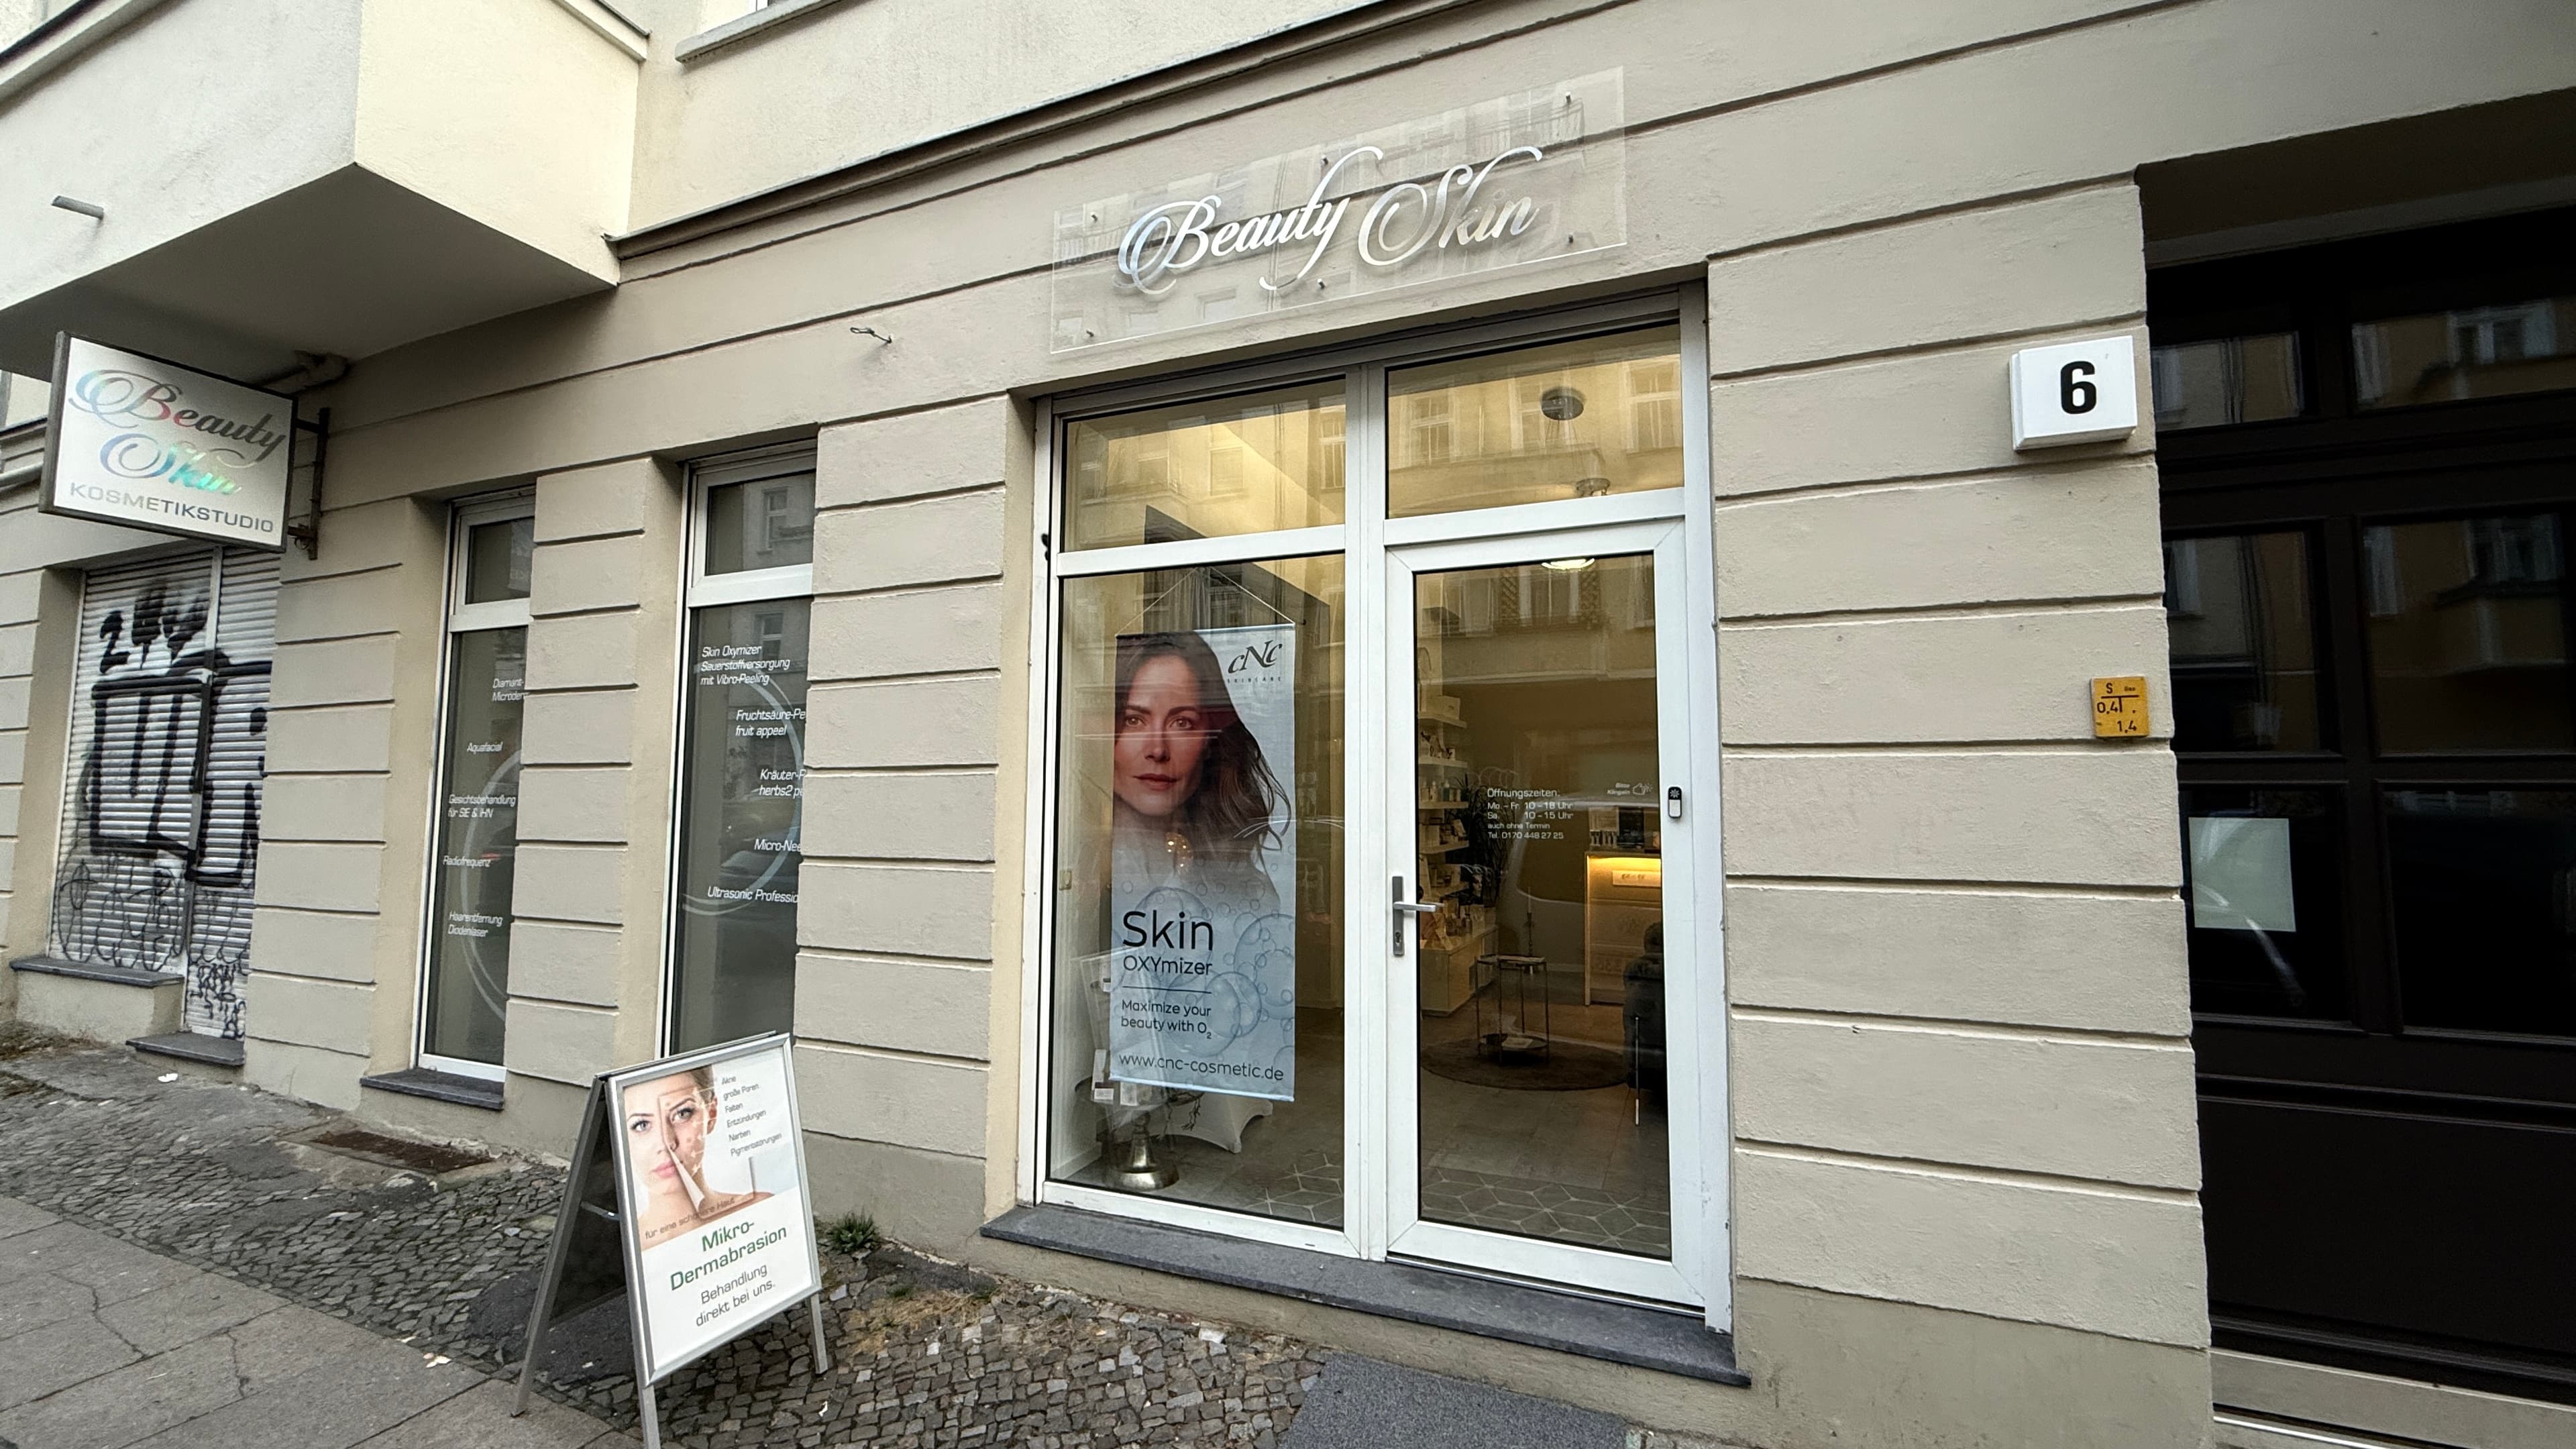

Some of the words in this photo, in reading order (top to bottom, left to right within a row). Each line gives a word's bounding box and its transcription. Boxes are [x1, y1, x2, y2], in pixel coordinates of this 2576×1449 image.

[1112, 146, 1383, 294] Beauty
[1358, 146, 1542, 266] Skin
[2061, 361, 2096, 415] 6
[68, 370, 286, 468] Beauty
[101, 433, 245, 495] Skin
[70, 482, 274, 532] KOSMETIKSTUDIO
[702, 645, 720, 657] Skin
[722, 645, 762, 659] Oxymizer
[701, 659, 791, 672] Sauerstoffversorgung
[700, 674, 714, 685] mit
[716, 673, 770, 686] Vibro-Peeling
[2106, 682, 2113, 694] S
[735, 724, 755, 737] fruit
[756, 724, 788, 739] appeel
[759, 784, 793, 797] herbs2
[448, 794, 516, 808] Gesichtsbehandlung
[1524, 802, 1536, 810] 10
[1544, 802, 1556, 810] 18
[1558, 802, 1574, 810] Uhr
[1524, 811, 1536, 819] 10
[1544, 811, 1556, 819] 15
[1558, 811, 1574, 819] Uhr
[443, 855, 492, 868] Radiofrequenz
[707, 885, 753, 900] Ultrasonic
[1122, 910, 1213, 951] Skin
[1123, 955, 1213, 975] OXYmizer
[1122, 1000, 1181, 1014] Maximize
[1183, 1006, 1212, 1017] your
[1120, 1016, 1165, 1032] beauty
[1167, 1020, 1194, 1032] with
[1118, 1054, 1284, 1081] www.cnc-cosmetic.de
[729, 1130, 751, 1142] Narben
[645, 1230, 658, 1240] für
[659, 1223, 677, 1234] eine
[716, 1197, 736, 1210] Haut
[702, 1221, 755, 1252] Mikro-
[669, 1227, 788, 1291] Dermabrasion
[700, 1265, 768, 1305] Behandlung
[696, 1301, 731, 1327] direkt
[733, 1291, 750, 1307] bei
[753, 1279, 776, 1297] uns.
